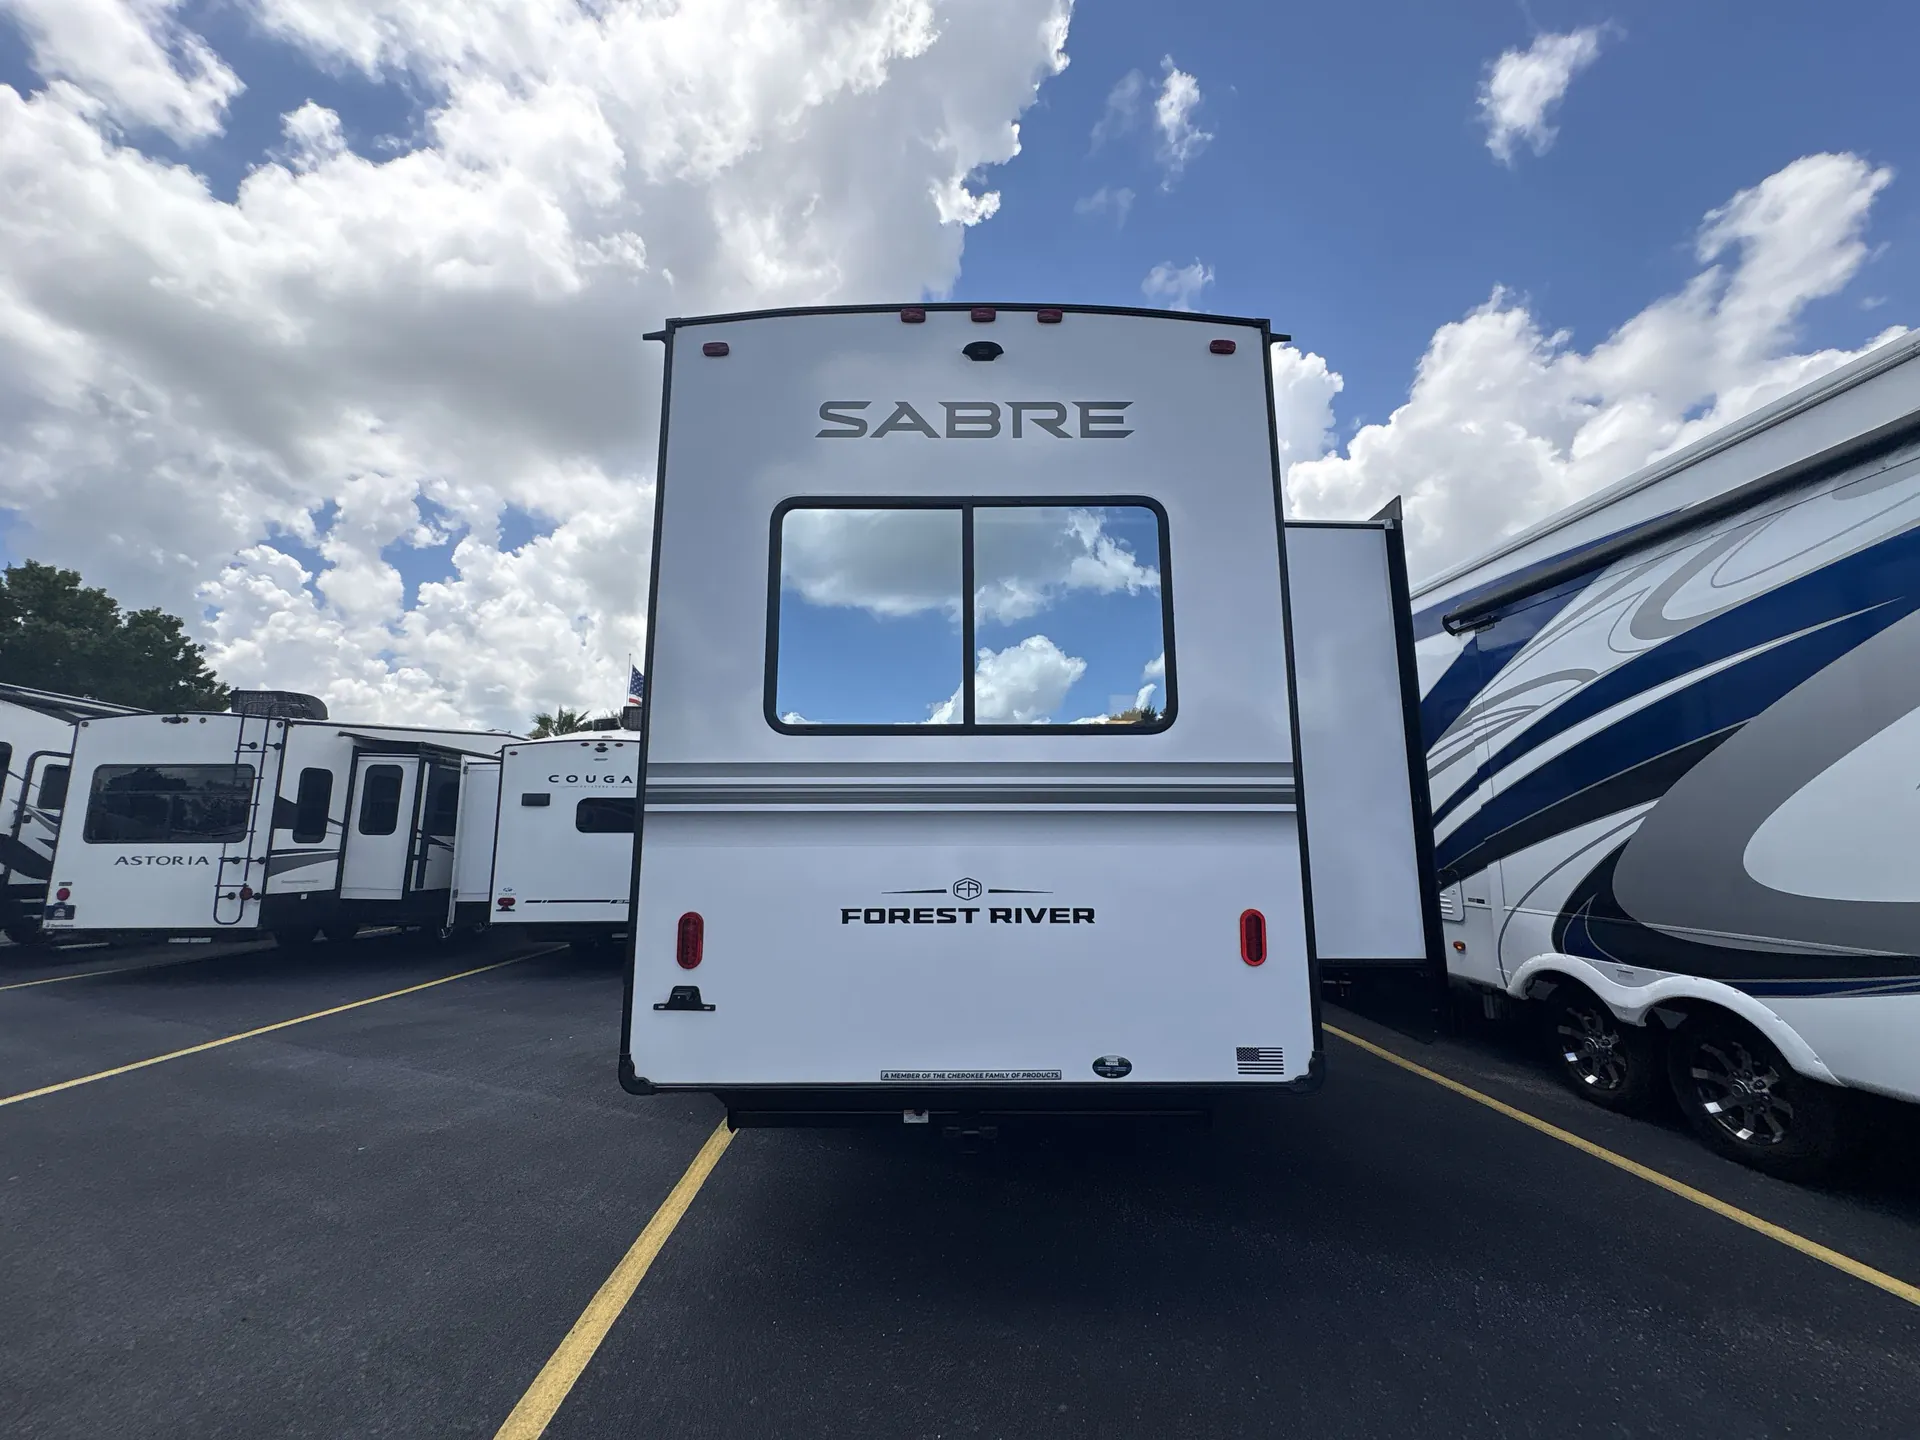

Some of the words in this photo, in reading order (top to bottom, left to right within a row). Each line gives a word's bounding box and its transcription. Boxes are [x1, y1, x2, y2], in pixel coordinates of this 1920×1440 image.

[814, 401, 1136, 438] SABRE
[548, 774, 633, 784] COUGA
[113, 855, 210, 866] ASTORIA
[840, 907, 980, 925] FOREST
[988, 907, 1096, 925] RIVER
